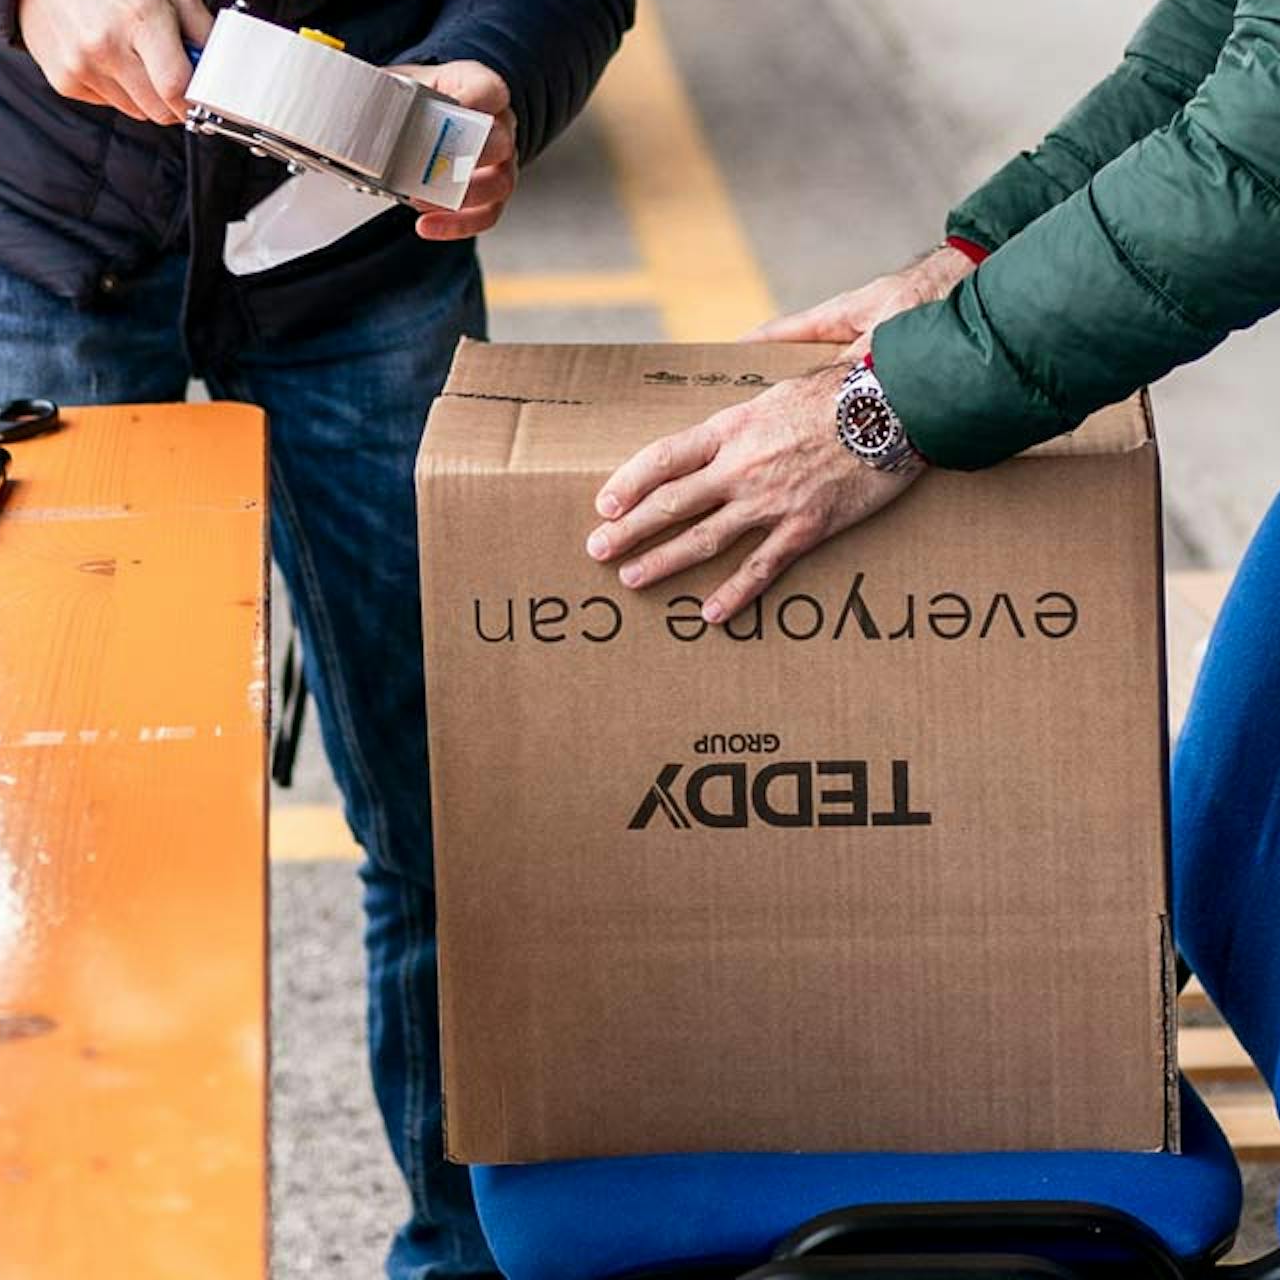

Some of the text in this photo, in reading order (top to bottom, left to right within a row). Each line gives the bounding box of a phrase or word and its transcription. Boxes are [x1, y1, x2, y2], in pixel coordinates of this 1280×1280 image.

[474, 571, 1078, 643] everyone can
[693, 733, 781, 754] GROUP
[626, 759, 933, 830] TEDDY
